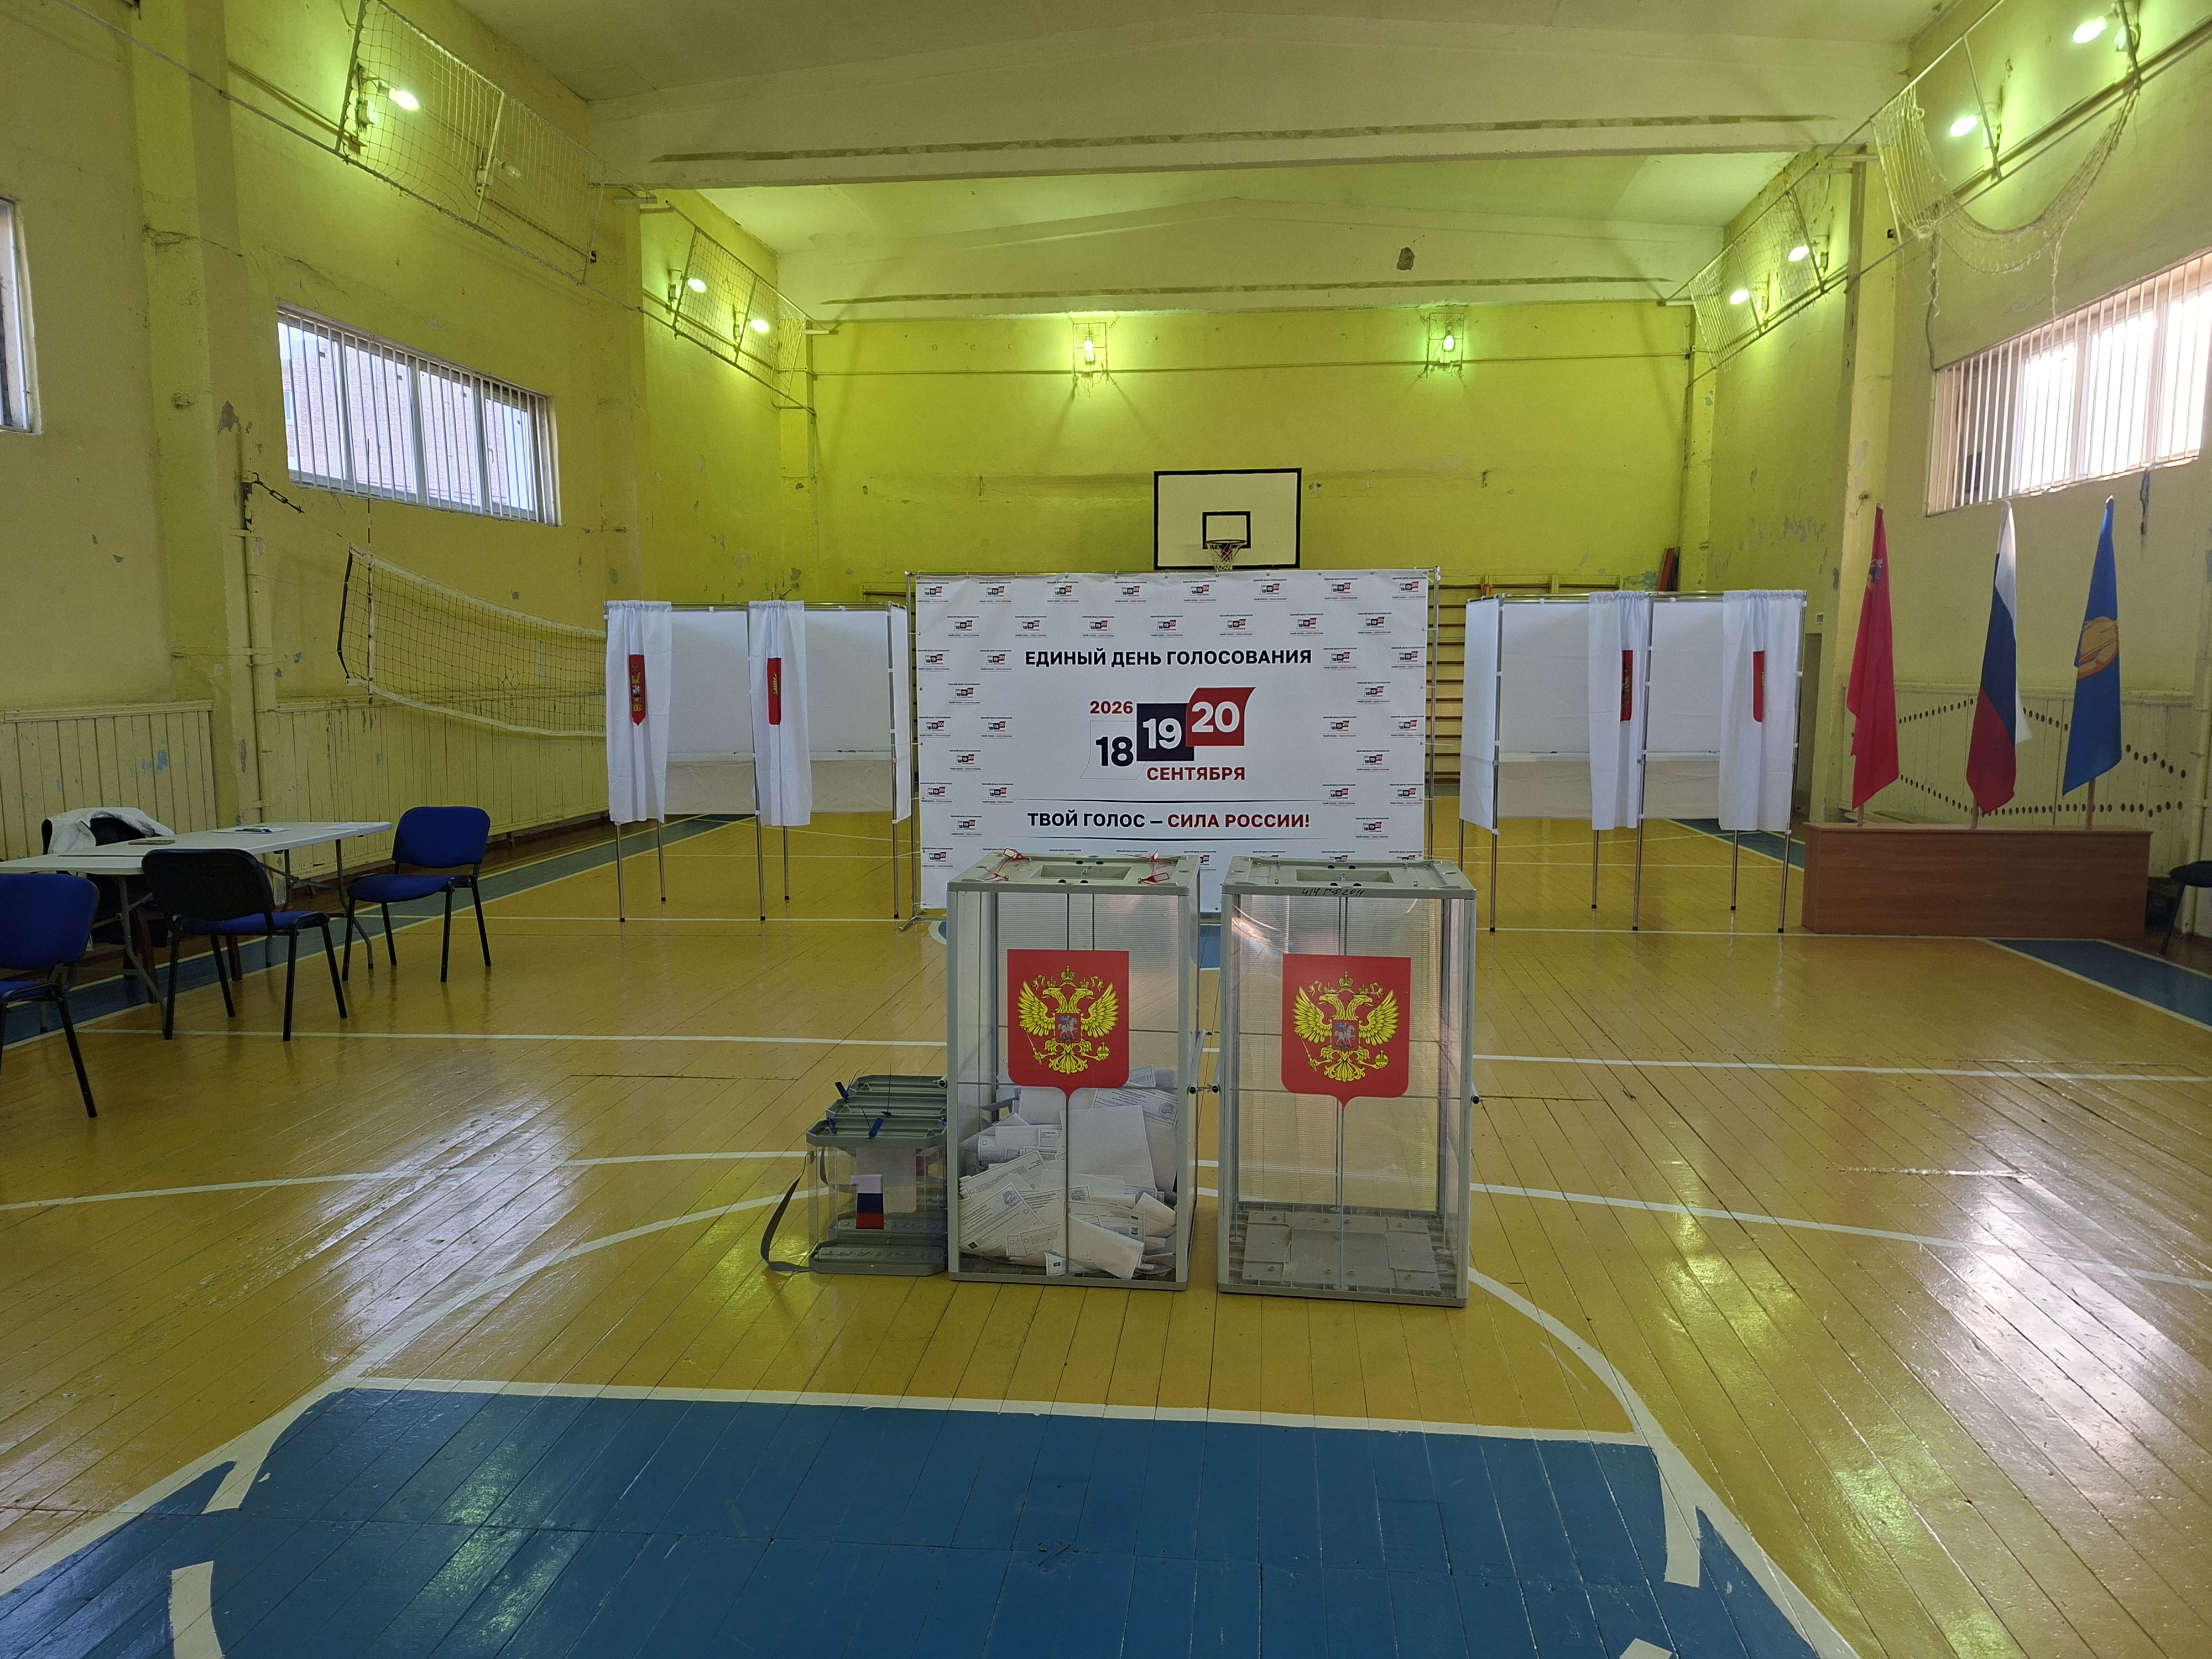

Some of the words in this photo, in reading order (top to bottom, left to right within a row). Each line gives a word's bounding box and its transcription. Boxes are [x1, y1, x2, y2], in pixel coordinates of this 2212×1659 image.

[1026, 648, 1105, 667] ЕДИНЫЙ
[1112, 651, 1161, 667] ДЕНЬ
[1167, 650, 1311, 665] ГОЛОСОВАНИЯ
[1090, 701, 1133, 714] 2026
[1096, 737, 1133, 766] 18
[1143, 718, 1181, 749] 19
[1192, 702, 1239, 732] 20
[1147, 767, 1244, 780] СЕНТЯБРЯ
[1027, 810, 1077, 826] ТВОЙ
[1084, 813, 1145, 827] ГОЛОС
[1168, 815, 1219, 827] СИЛА
[1225, 815, 1309, 827] РОССИИ!
